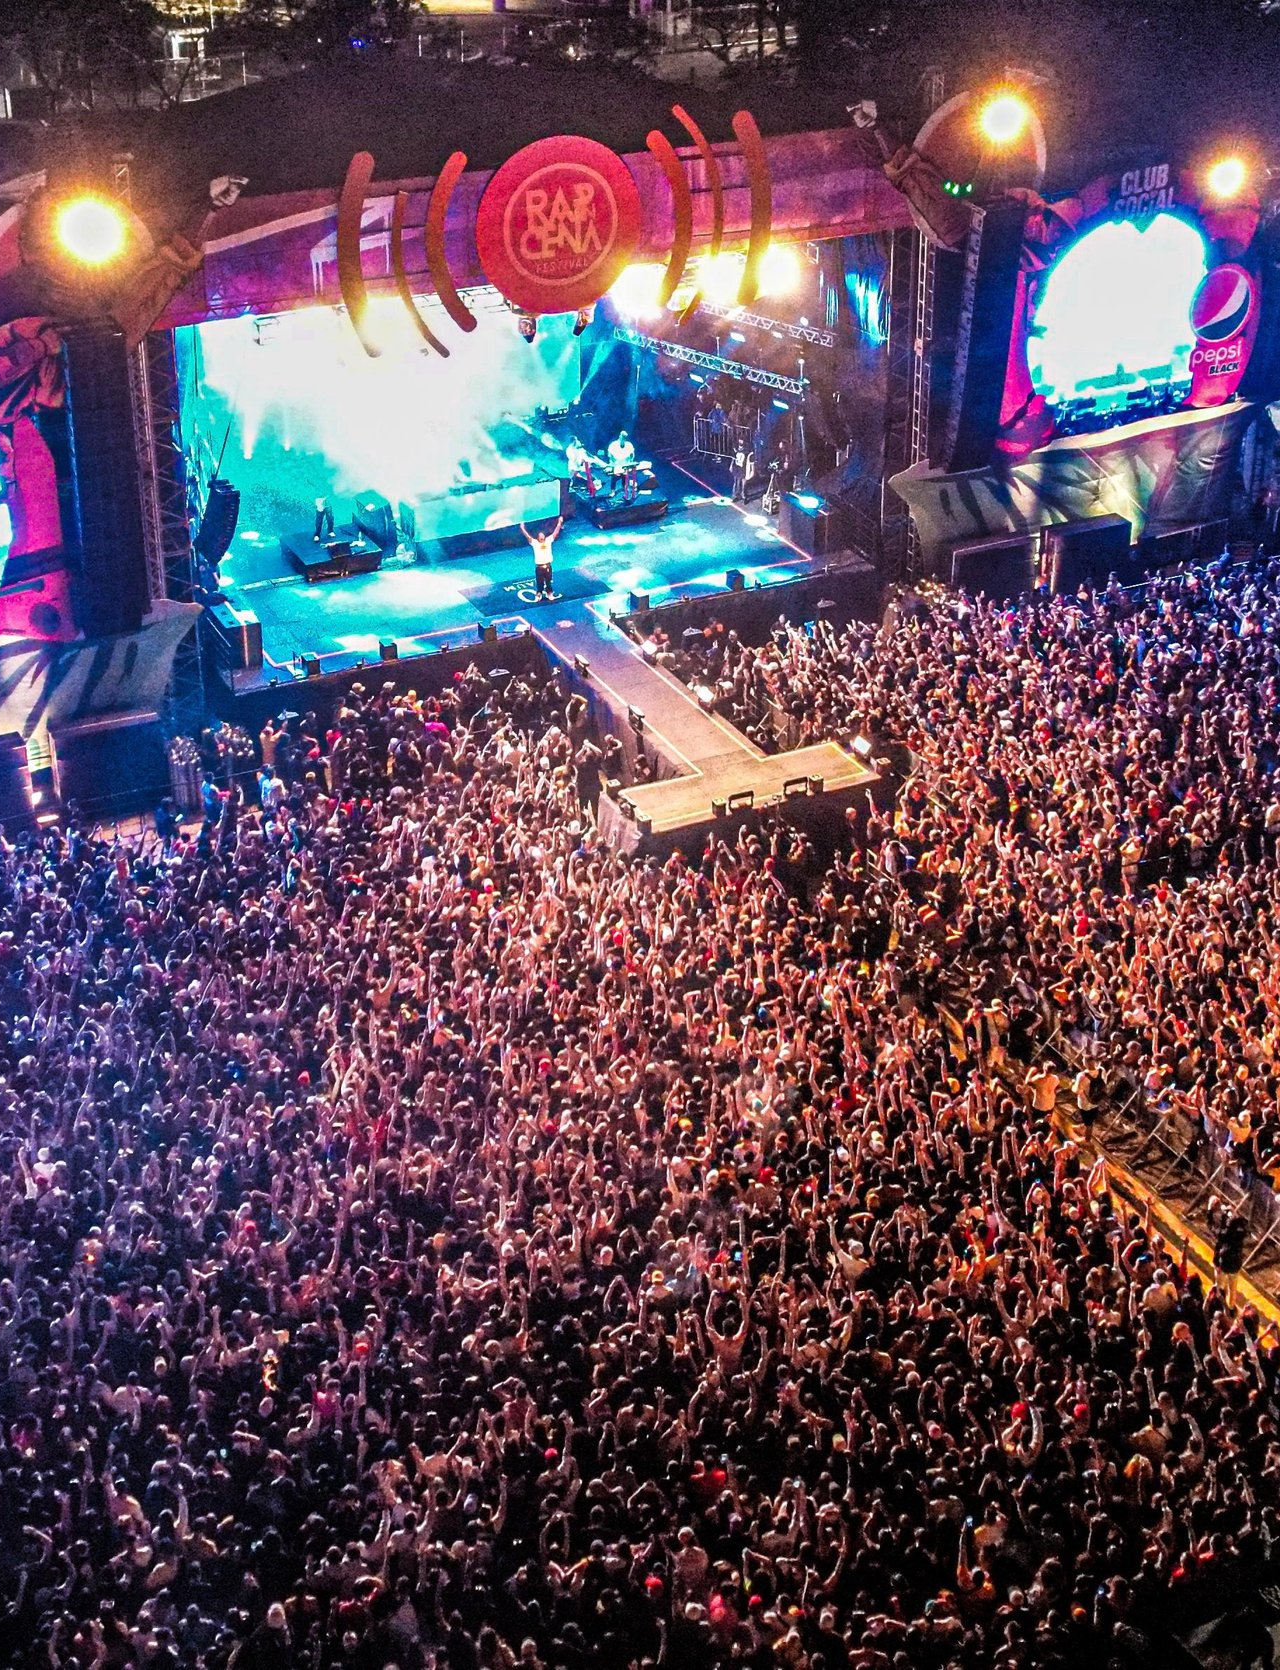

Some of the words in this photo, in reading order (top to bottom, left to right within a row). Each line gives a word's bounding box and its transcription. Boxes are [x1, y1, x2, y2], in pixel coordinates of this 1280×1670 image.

[1120, 163, 1170, 197] CLUB
[525, 182, 595, 226] RAP
[519, 218, 602, 260] CENA
[537, 257, 589, 274] FESTIVAL
[1191, 340, 1242, 368] pepsi
[1208, 361, 1240, 375] BLACK
